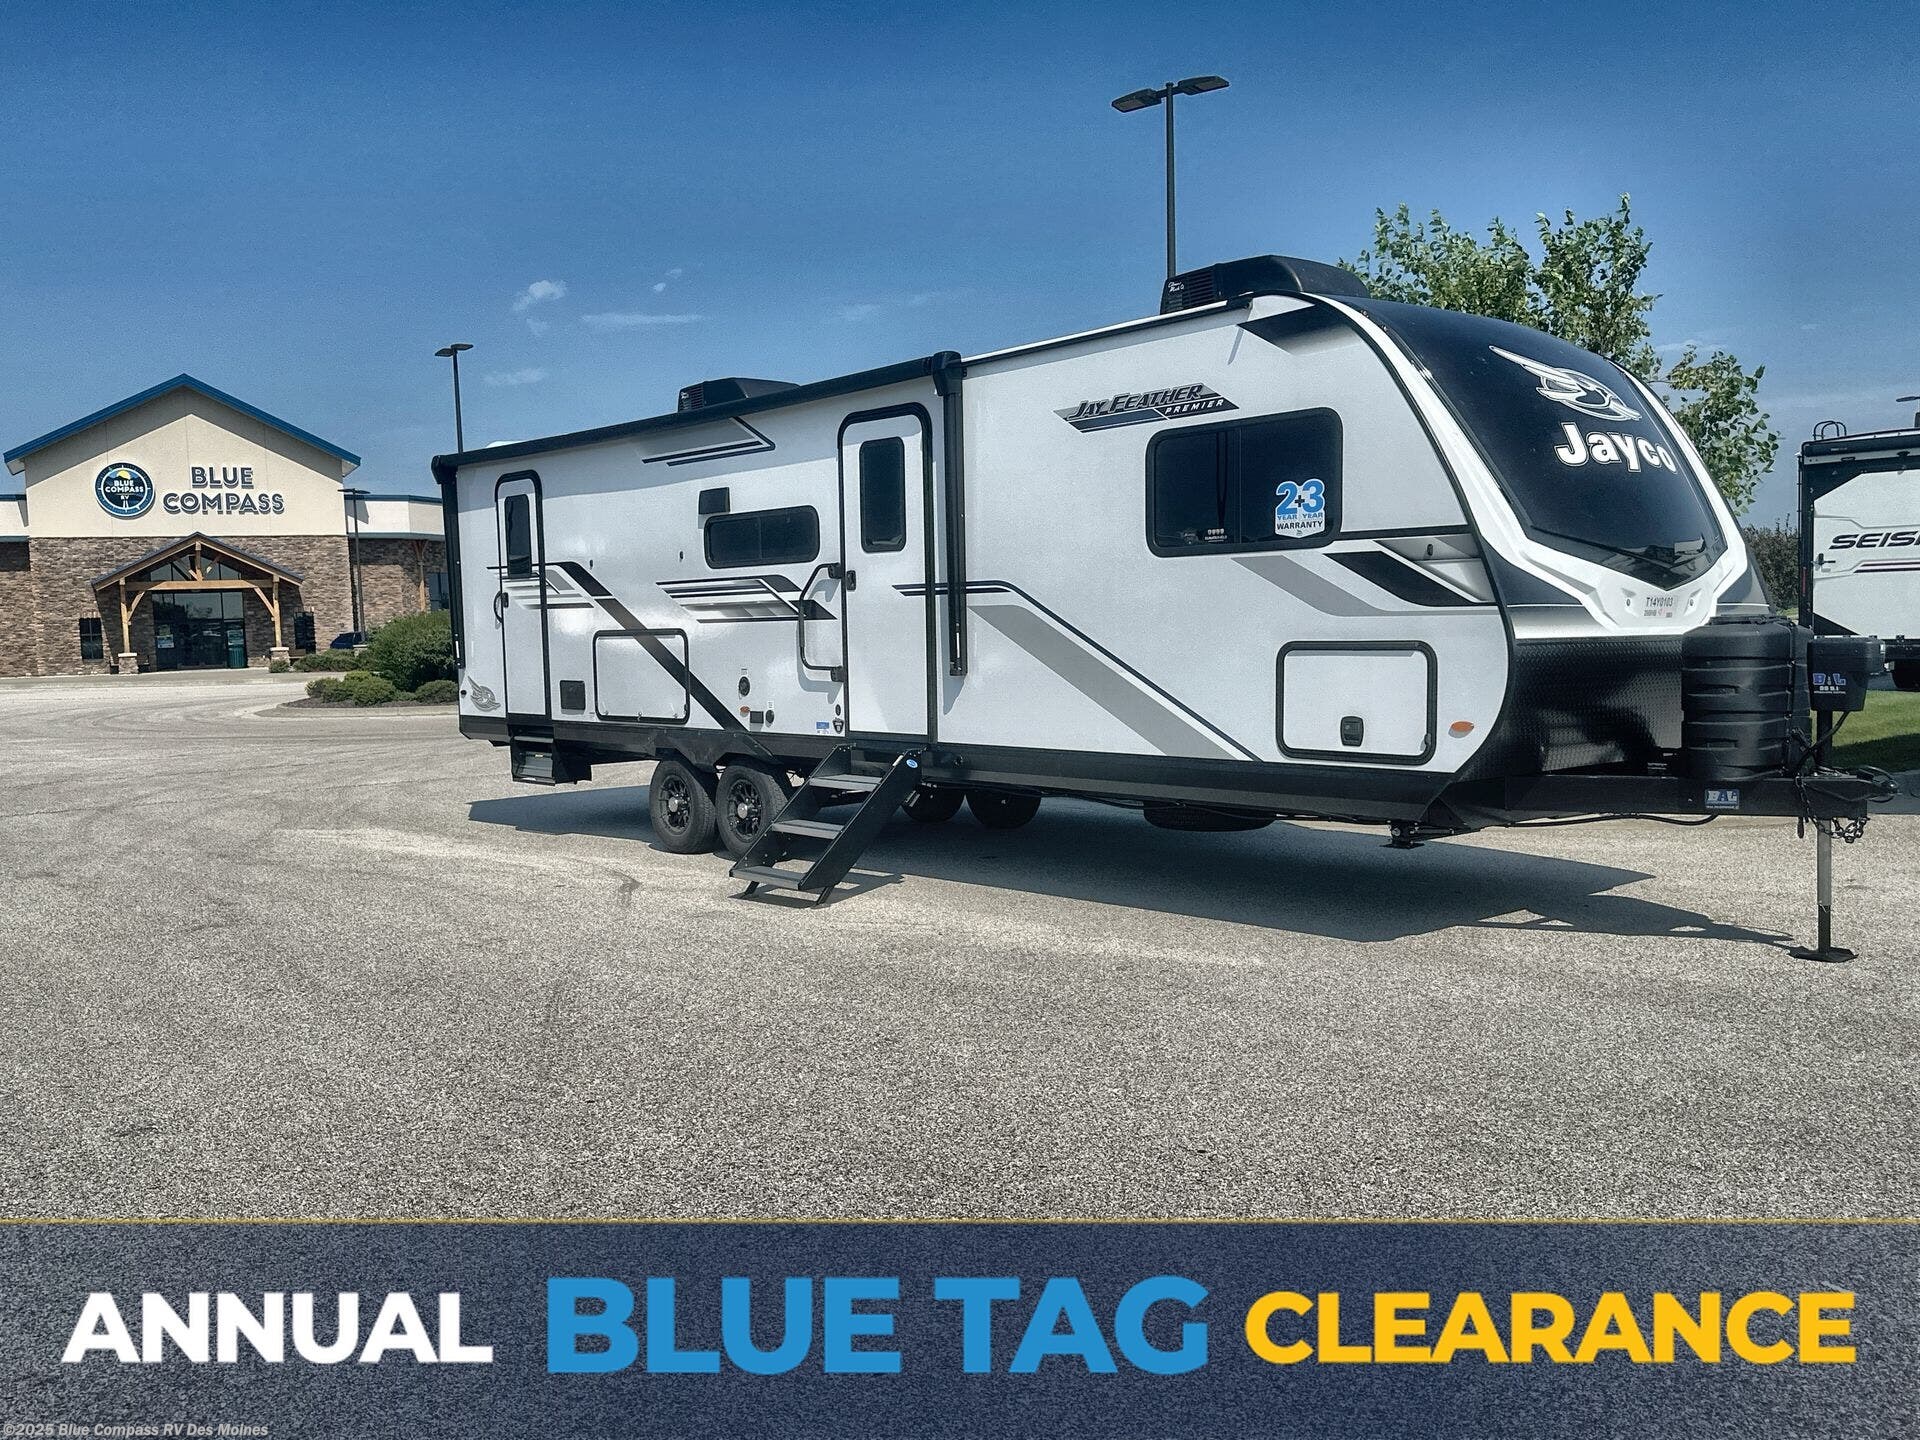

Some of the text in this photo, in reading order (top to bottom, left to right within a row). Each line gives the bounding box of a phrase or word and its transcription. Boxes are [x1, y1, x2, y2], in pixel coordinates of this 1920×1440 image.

[1067, 384, 1205, 421] JAY FEATHER
[1164, 398, 1225, 415] PREMIER
[1554, 422, 1678, 473] Jayco
[191, 466, 254, 489] BLUE
[163, 492, 285, 515] COMPASS
[1277, 520, 1323, 530] WARRANTY
[1302, 512, 1323, 520] YEAR
[1829, 530, 1920, 550] SEIS
